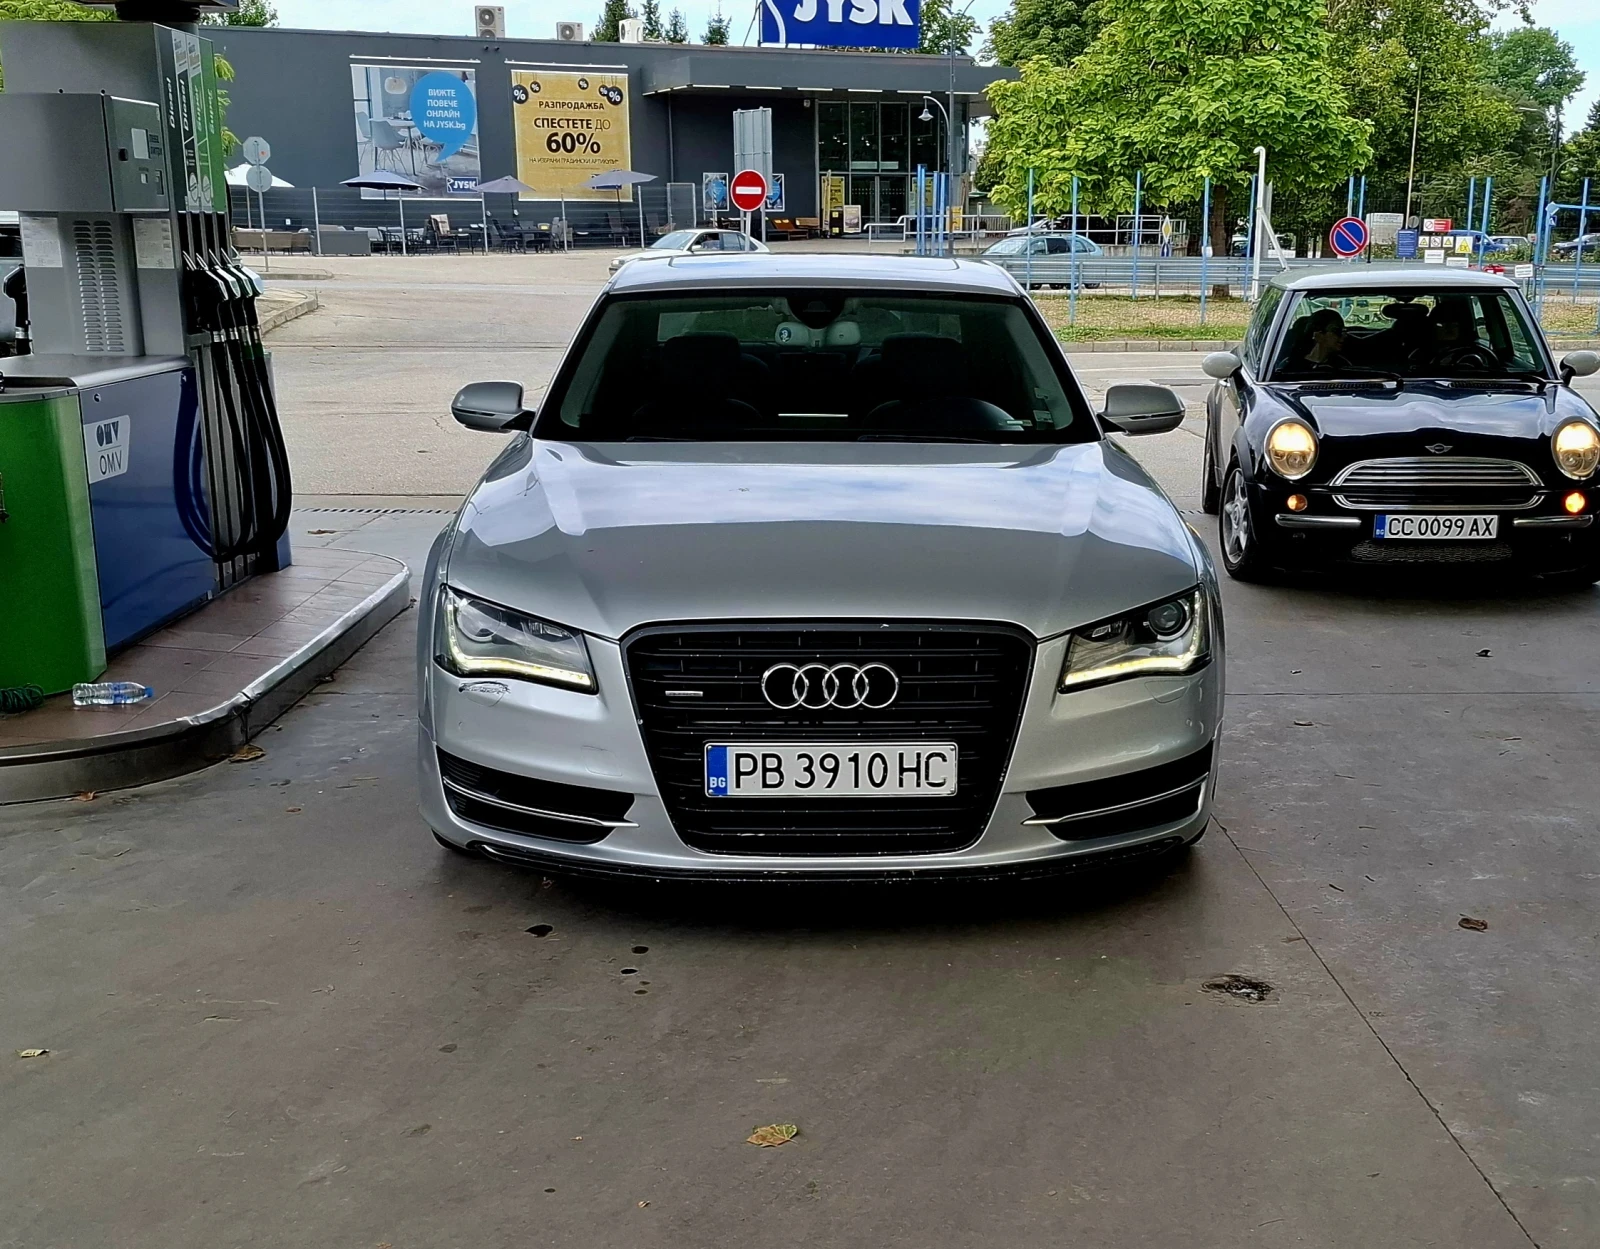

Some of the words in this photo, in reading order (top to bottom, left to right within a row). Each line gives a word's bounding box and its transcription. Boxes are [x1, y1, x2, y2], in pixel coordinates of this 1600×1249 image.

[793, 0, 914, 26] JYSK
[531, 83, 540, 91] %
[579, 80, 587, 88] %
[428, 89, 456, 97] ВИЖТЕ
[513, 89, 525, 100] %
[609, 91, 621, 102] %
[166, 77, 175, 129] Diesel
[179, 79, 189, 131] Diesel
[427, 99, 458, 107] ПОВЕЧЕ
[538, 101, 605, 110] РАЗПРОДАЖБА
[426, 109, 460, 118] ОНЛАЙН
[436, 121, 466, 130] JYSK.bg
[533, 117, 593, 130] СПЕСТЕТЕ
[595, 119, 611, 131] ДО
[546, 132, 601, 154] 60%
[453, 180, 476, 189] JYSK
[99, 450, 122, 476] OMV
[1388, 518, 1414, 536] CC
[1418, 517, 1465, 536] 0099
[1468, 518, 1494, 536] AX
[734, 752, 785, 789] PB
[794, 752, 889, 789] 3910
[898, 751, 948, 789] HC
[709, 777, 726, 788] BG
